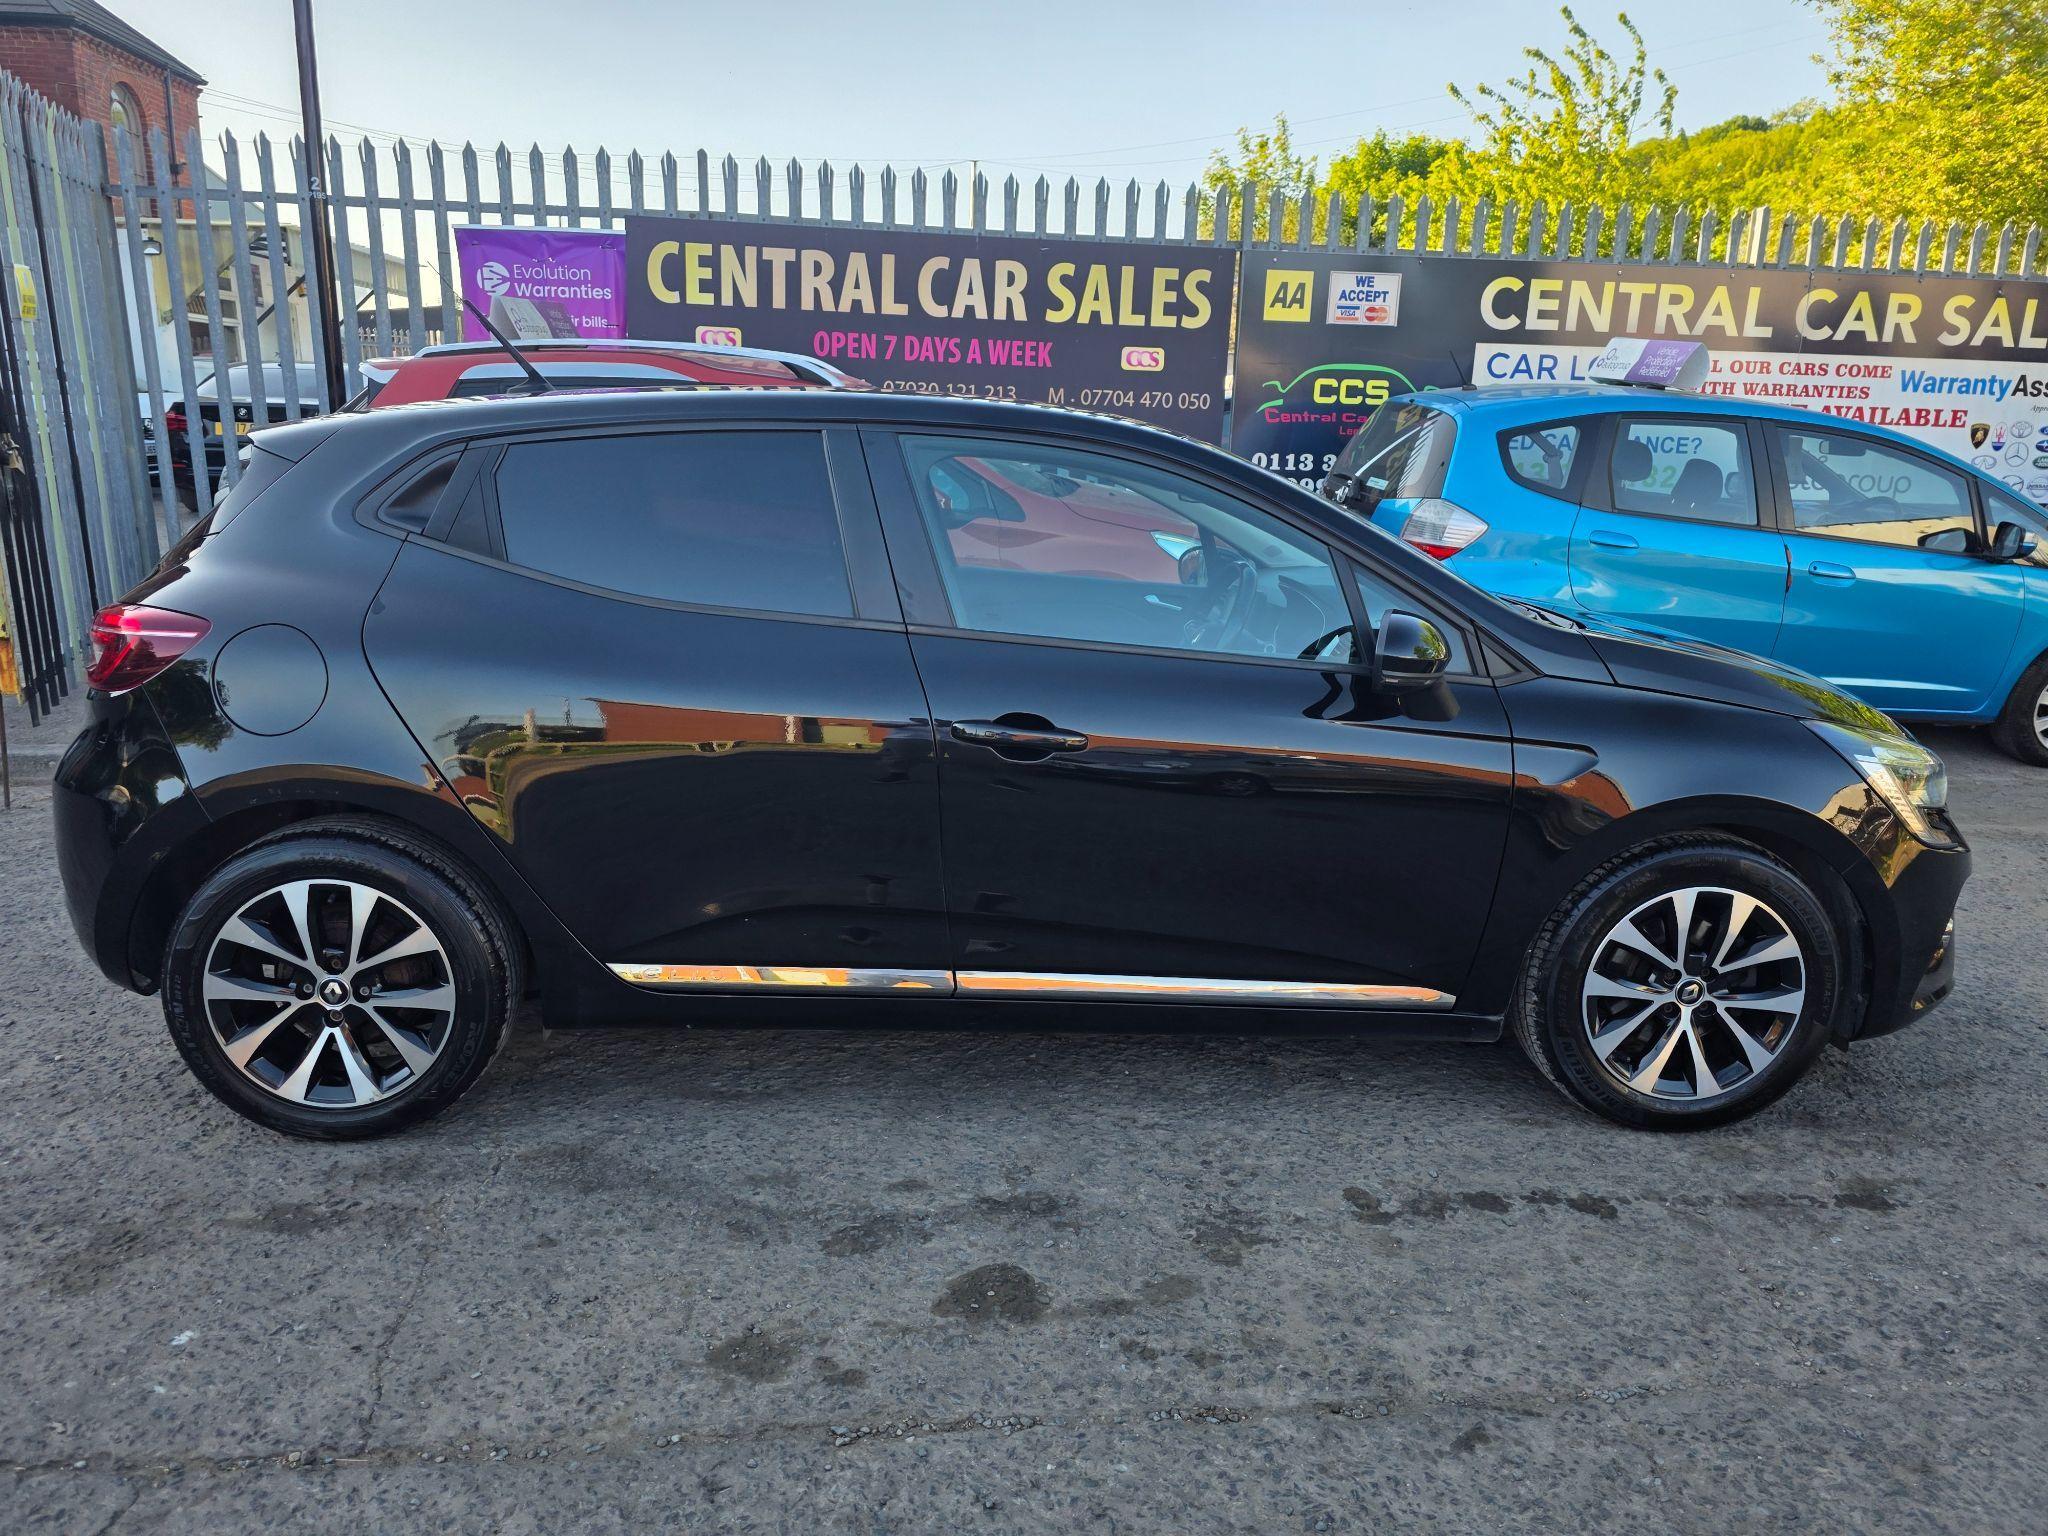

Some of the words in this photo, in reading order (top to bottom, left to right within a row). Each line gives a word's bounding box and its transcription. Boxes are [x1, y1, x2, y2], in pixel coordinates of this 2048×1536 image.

[513, 264, 591, 281] Evolution
[1355, 275, 1375, 288] WE
[514, 282, 612, 300] Warranties
[646, 240, 909, 317] CENTRAL
[917, 256, 1029, 322] CAR
[1045, 262, 1212, 329] SALES
[1269, 281, 1307, 310] AA
[1338, 289, 1389, 303] ACCEPT
[1340, 309, 1356, 317] VISA
[1480, 276, 1774, 339] CENTRAL
[1795, 288, 1921, 344] CAR
[1937, 293, 2048, 349] SAL
[813, 331, 877, 360] OPEN
[883, 335, 899, 361] 7
[904, 336, 962, 365] DAYS
[966, 339, 982, 365] A
[988, 339, 1054, 368] WEEK
[1486, 352, 1559, 380] CAR
[1729, 360, 1772, 375] OUR
[1778, 361, 1829, 377] CARS
[1835, 363, 1893, 378] COME
[1080, 388, 1135, 407] 07704
[1140, 391, 1173, 408] 470
[1178, 392, 1211, 410] 050
[1313, 378, 1390, 405] CCS
[1743, 383, 1870, 400] WARRANTIES
[1264, 408, 1337, 423] Central
[1252, 452, 1314, 472] 0113
